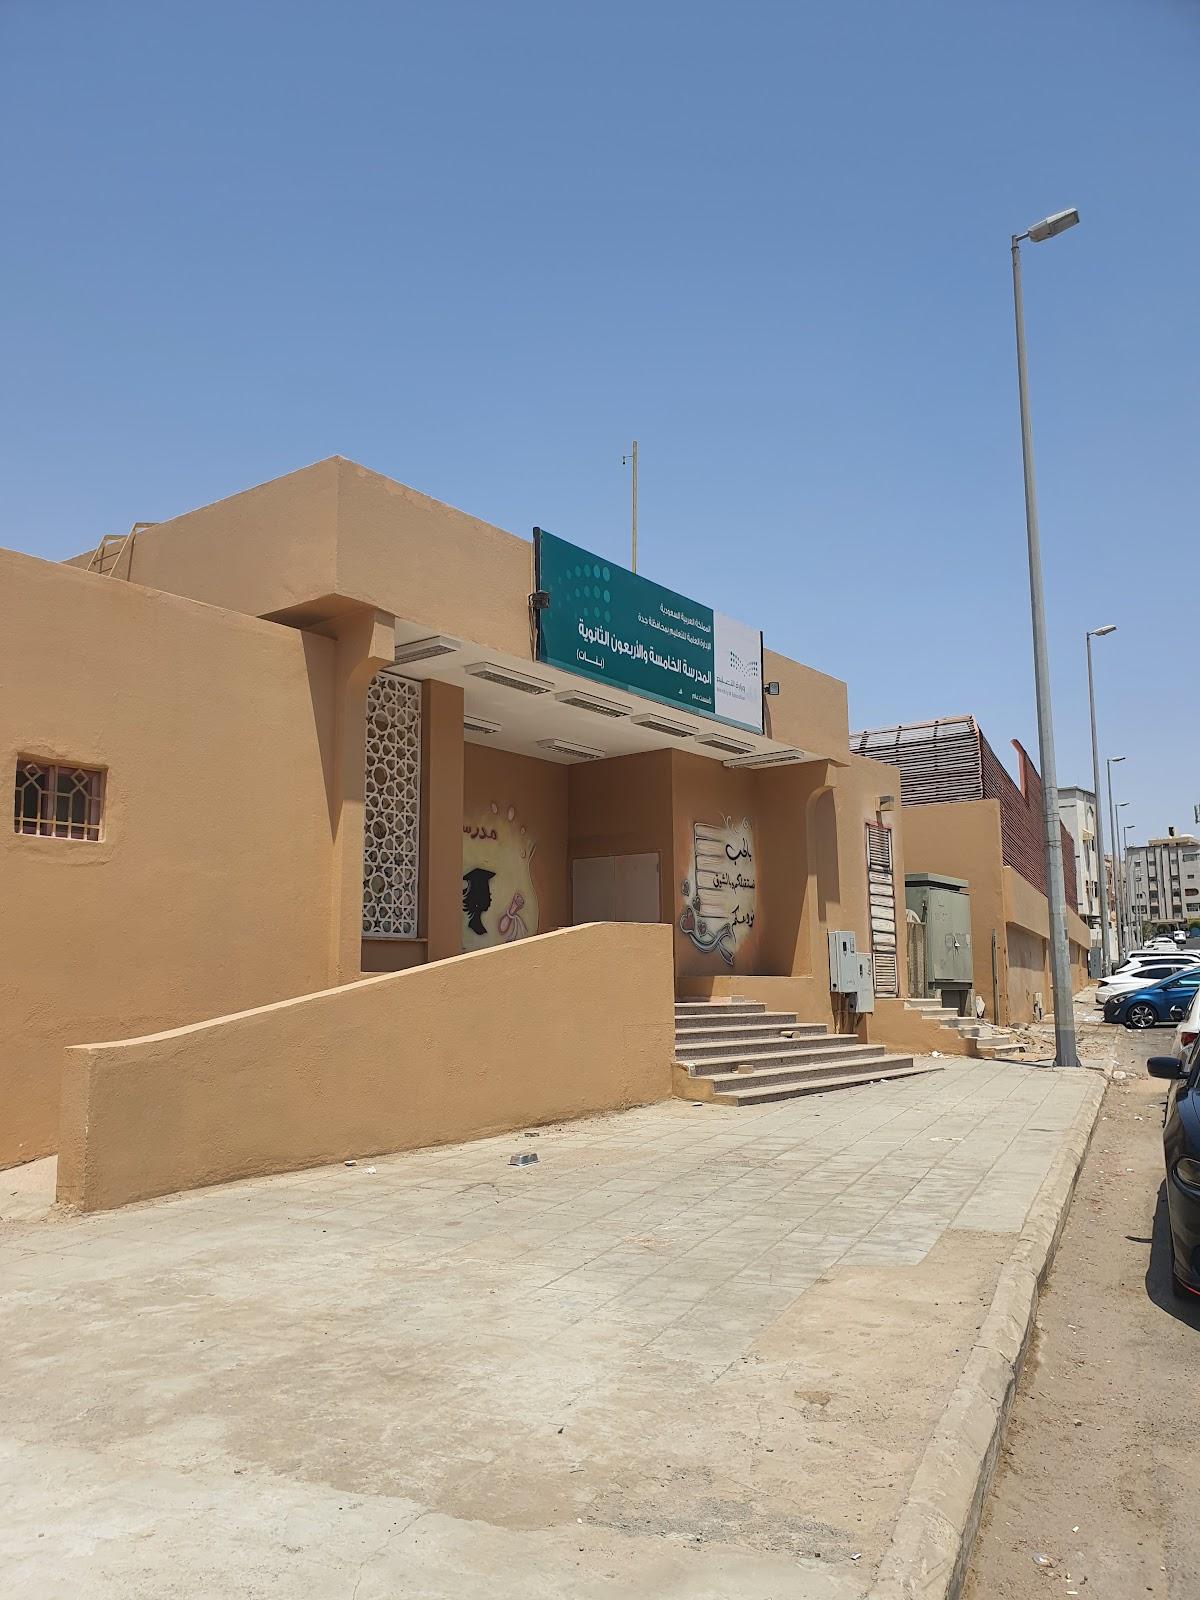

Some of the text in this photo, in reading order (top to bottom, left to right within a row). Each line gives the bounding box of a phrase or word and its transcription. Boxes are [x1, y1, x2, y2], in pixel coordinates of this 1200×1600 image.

[637, 612, 649, 625] جدة
[659, 602, 711, 633] المملكة العربية السعودية
[578, 617, 712, 685] المدرسة الخامسة والأربعون الثانوية
[725, 838, 752, 866] بالحب
